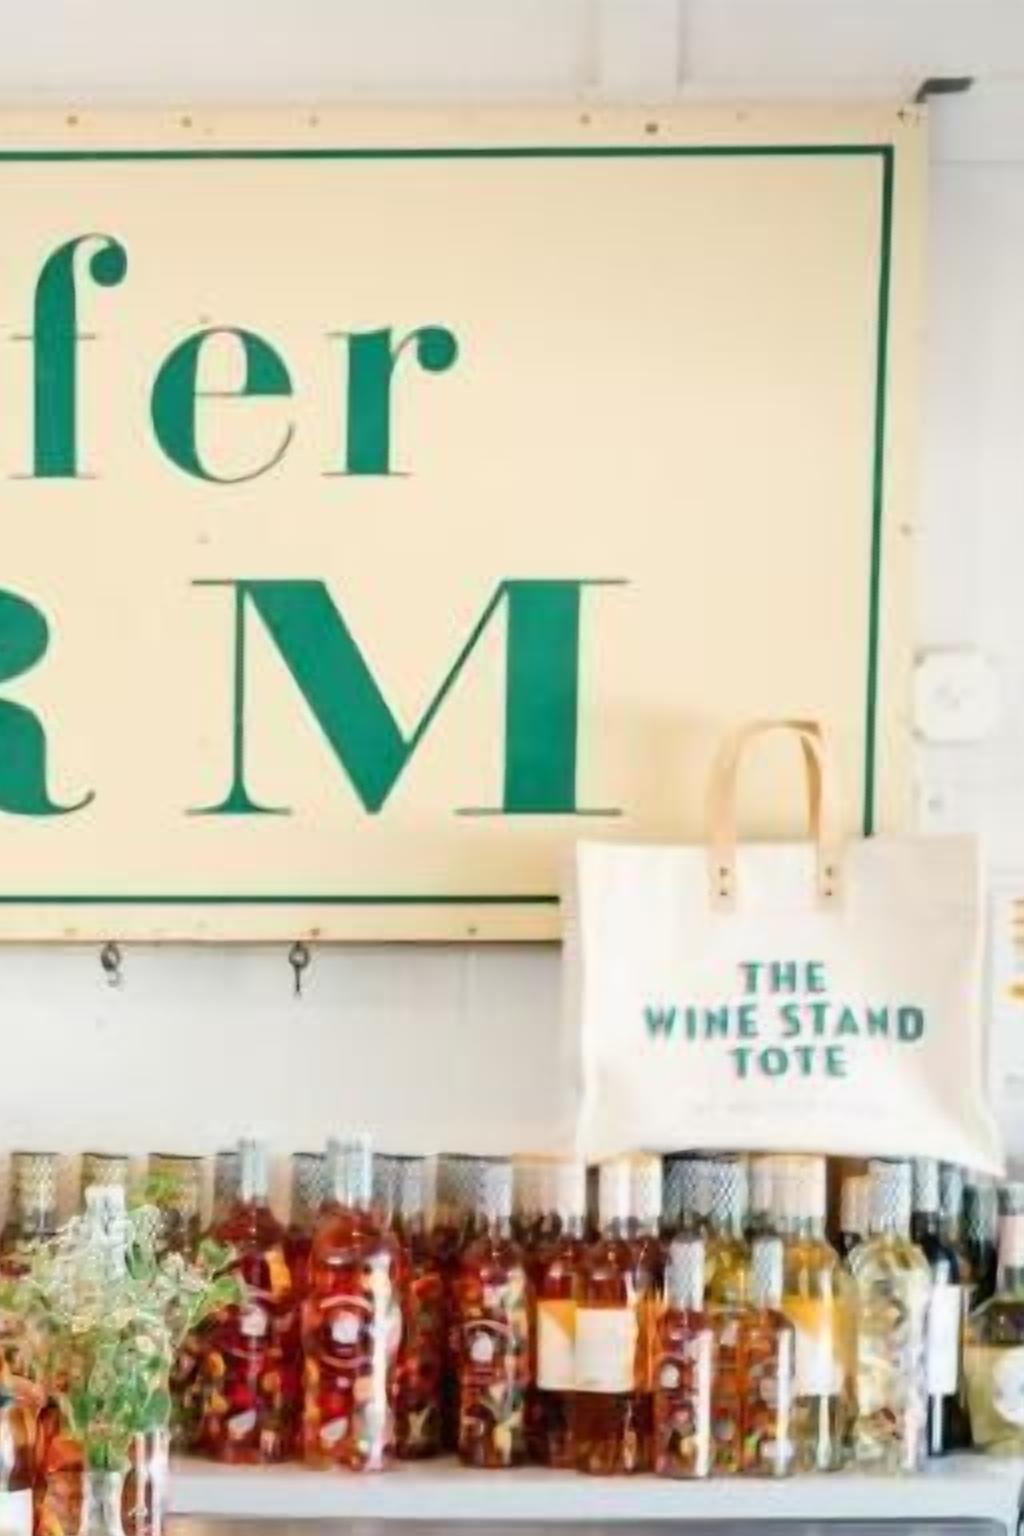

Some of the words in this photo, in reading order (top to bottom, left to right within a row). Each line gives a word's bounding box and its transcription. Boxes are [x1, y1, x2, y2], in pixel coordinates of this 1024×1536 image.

[739, 960, 827, 994] THE
[643, 1003, 759, 1041] WINE
[780, 1003, 925, 1042] STAND
[729, 1045, 848, 1079] TOTE
